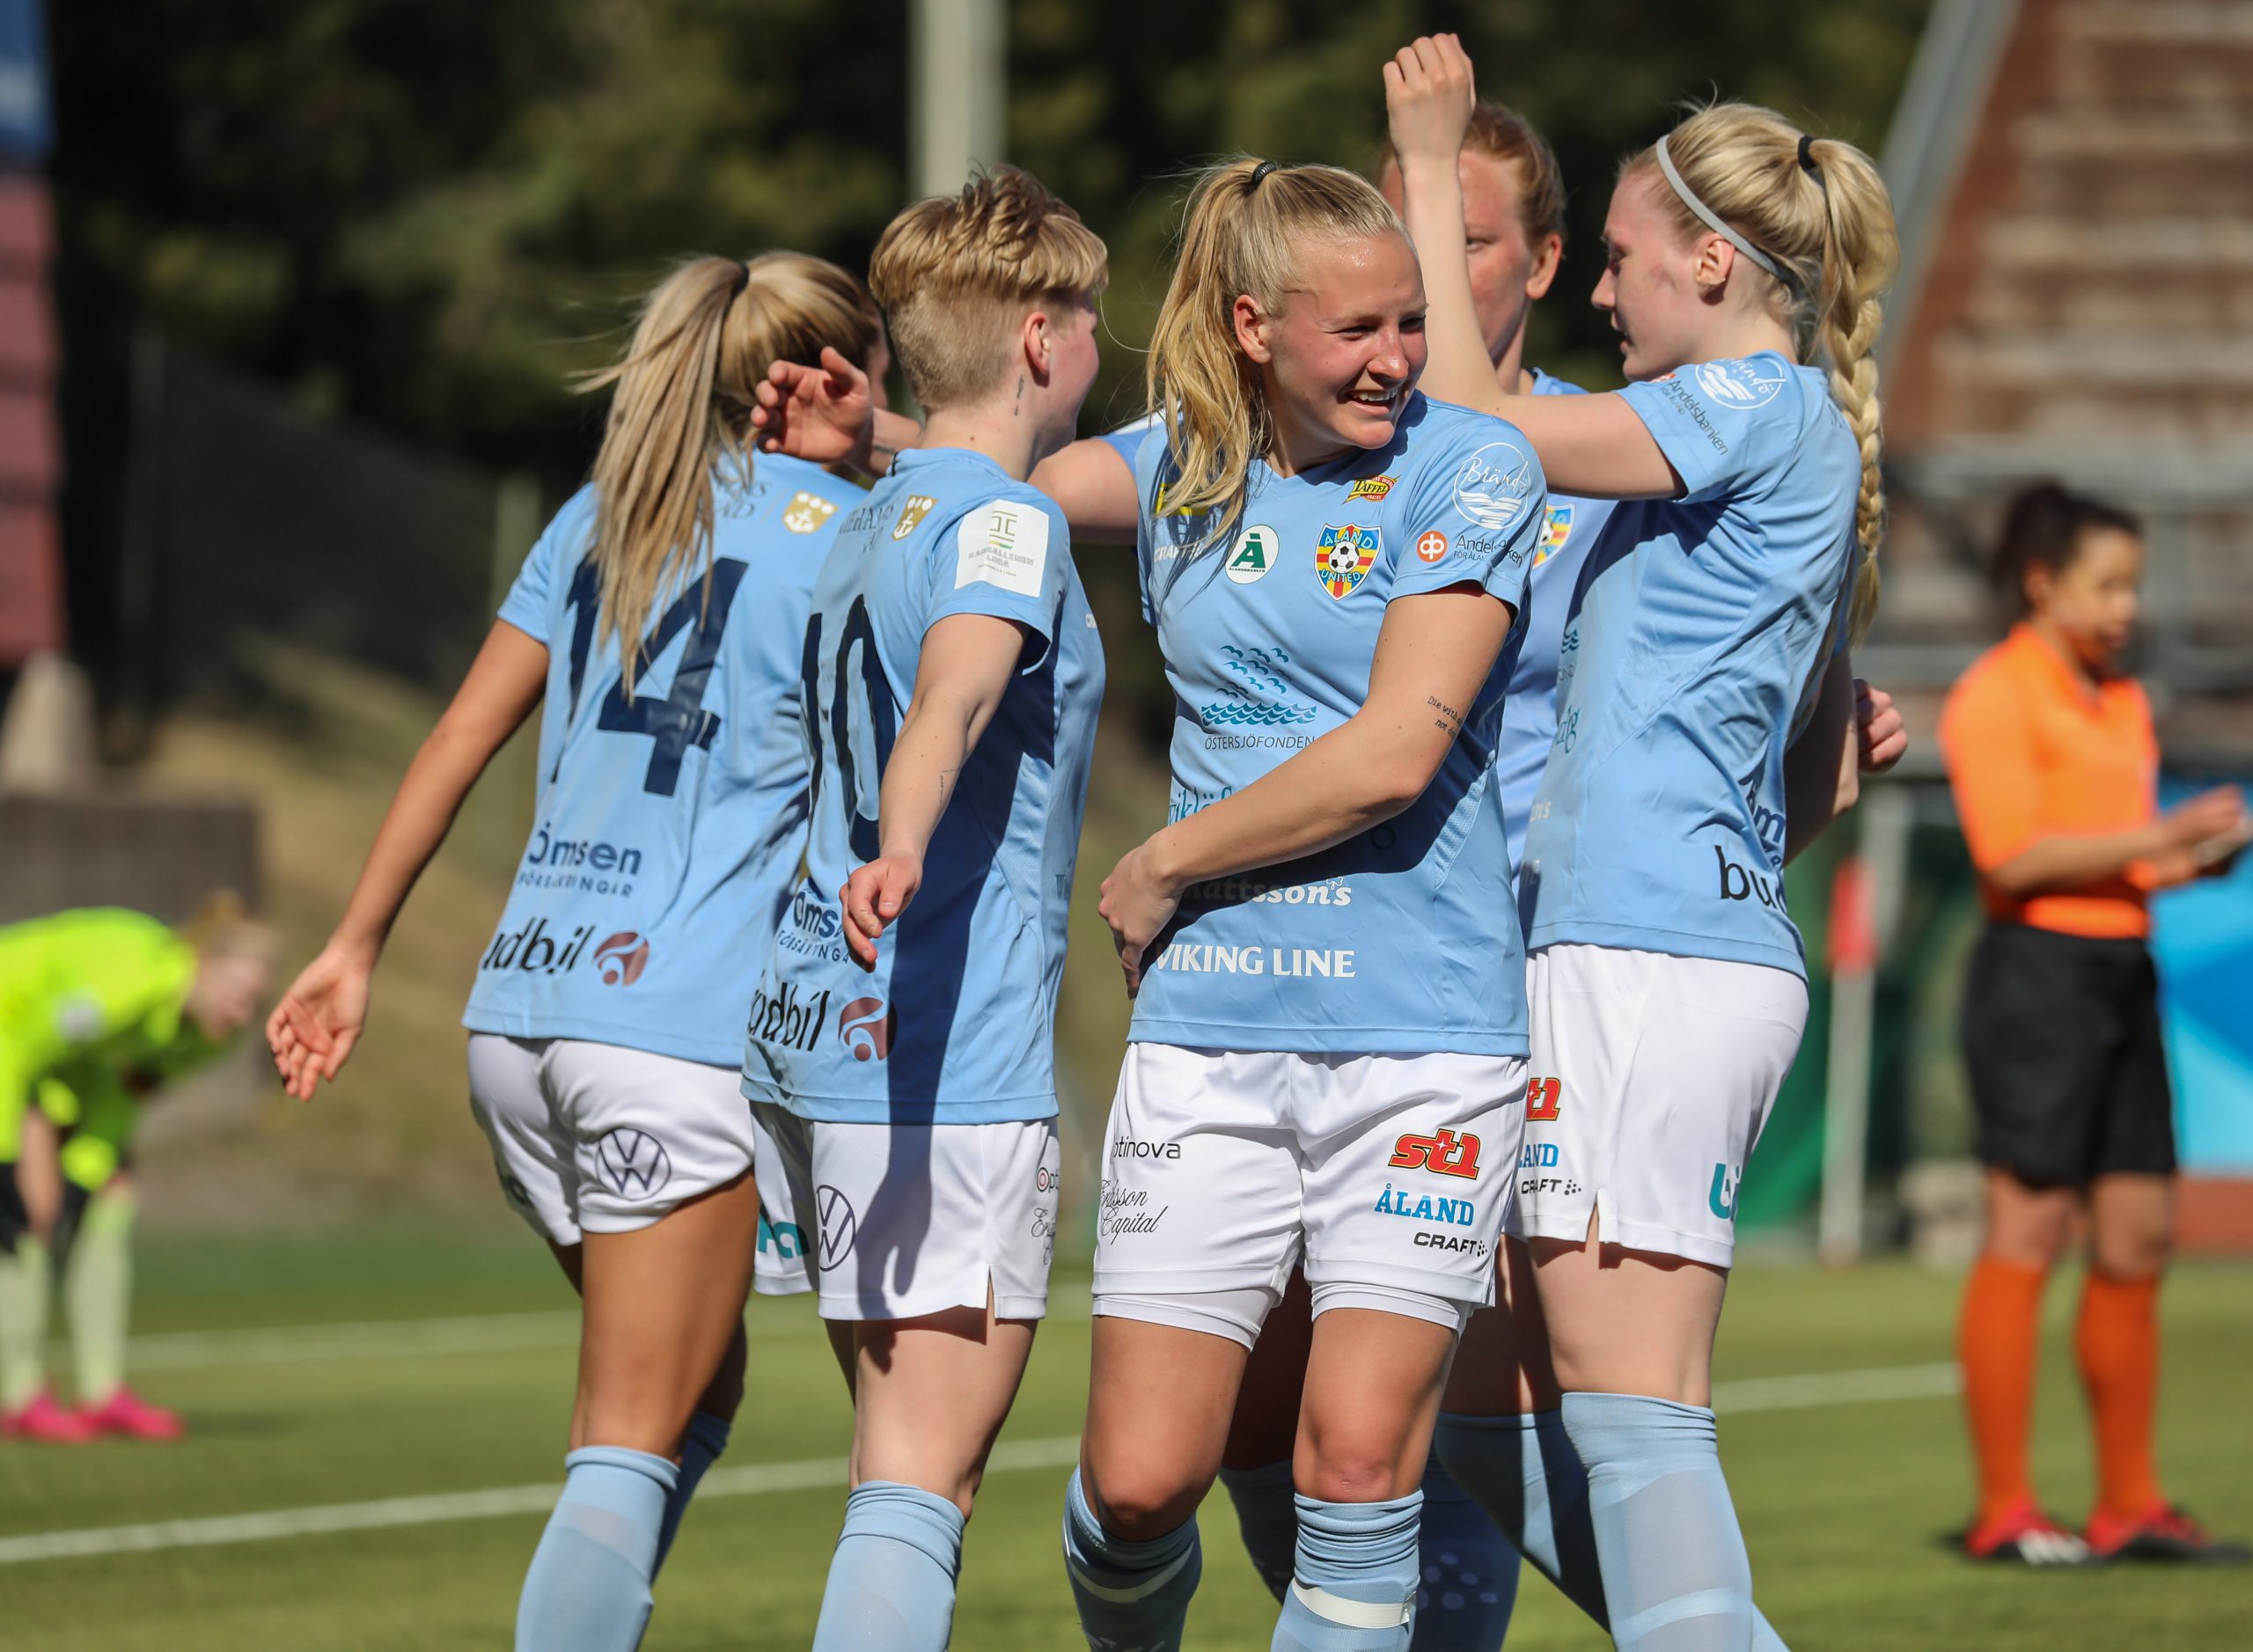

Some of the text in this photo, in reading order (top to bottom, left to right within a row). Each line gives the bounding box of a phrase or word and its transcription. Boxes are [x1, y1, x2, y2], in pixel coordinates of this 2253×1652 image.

[1668, 379, 1728, 456] Andelsbanken
[1353, 479, 1387, 493] TAFFEL
[1323, 530, 1374, 550] ÅLAND
[1321, 568, 1361, 583] UNITED
[550, 547, 749, 797] 14
[800, 593, 896, 863] 10
[1156, 943, 1357, 978] VIKING LINE
[1521, 1179, 1563, 1196] CRAFT
[1374, 1183, 1475, 1227] ÅLAND
[1413, 1231, 1478, 1256] CRAFT
